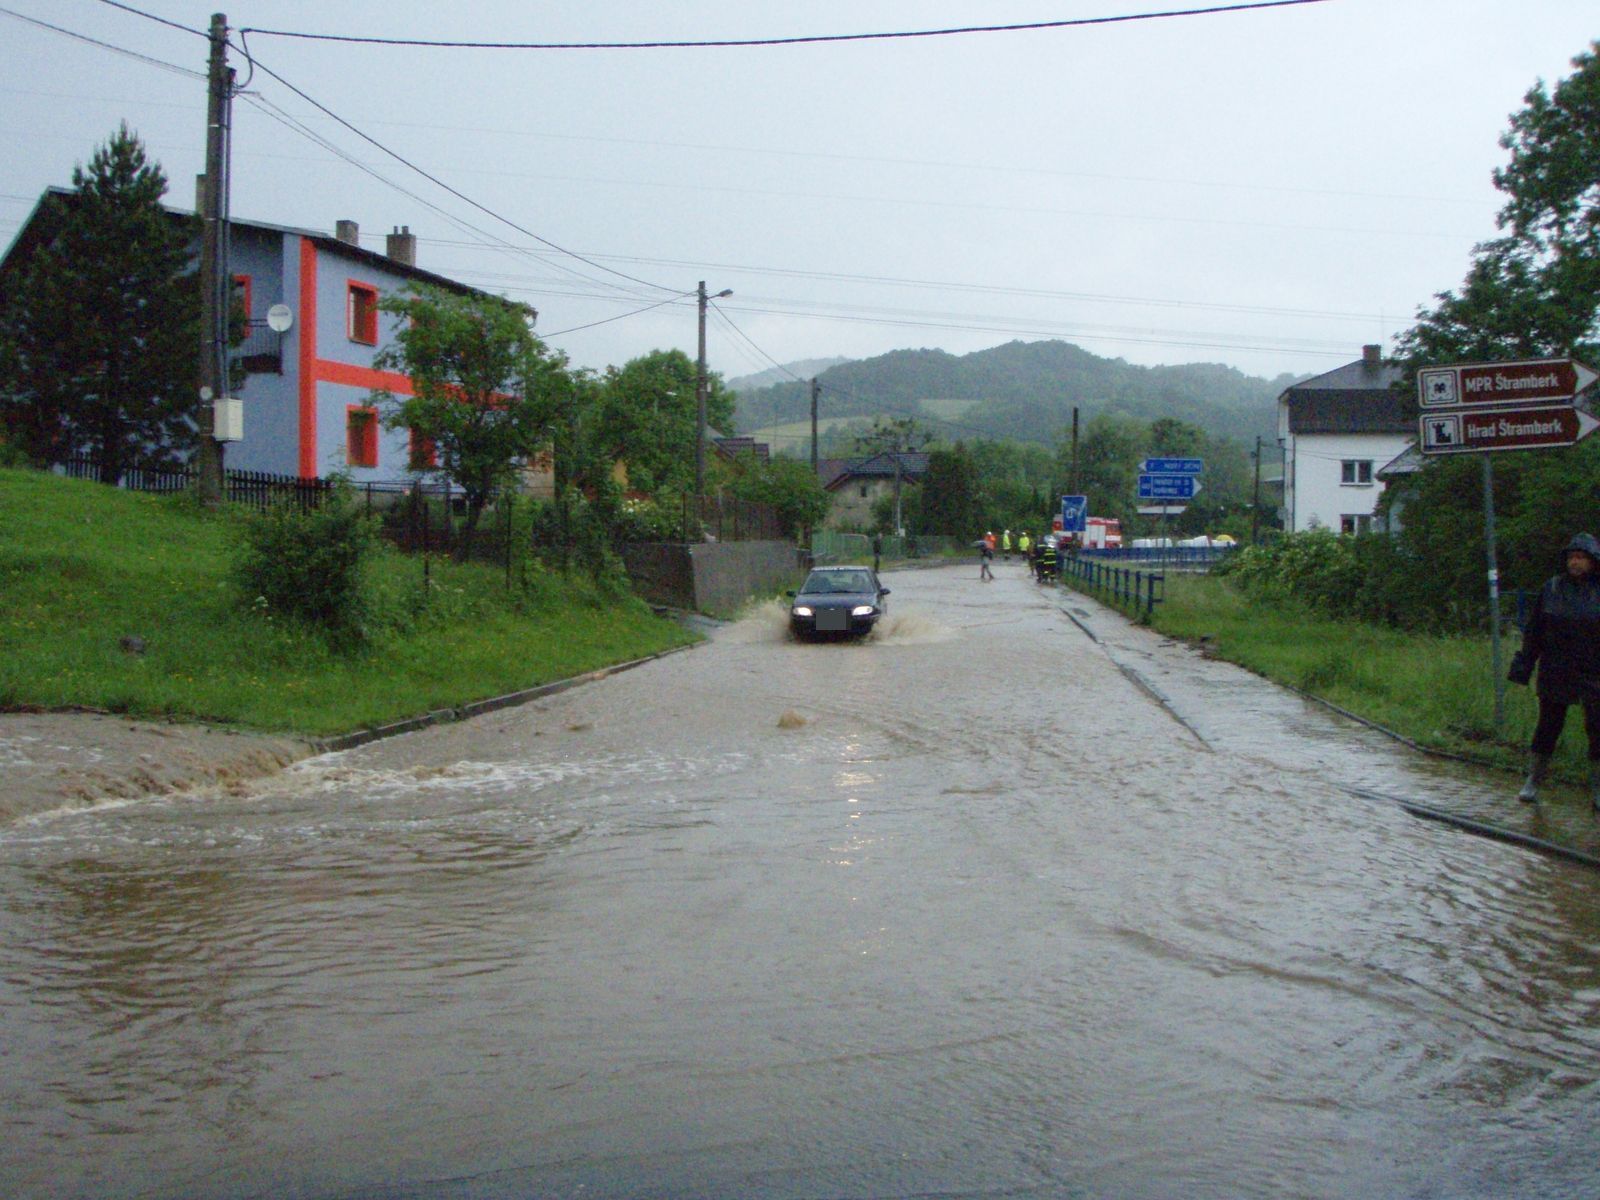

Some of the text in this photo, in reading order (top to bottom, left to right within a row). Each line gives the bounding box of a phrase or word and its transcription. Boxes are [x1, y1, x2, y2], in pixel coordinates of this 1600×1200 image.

[1466, 373, 1559, 392] MPR Štramberk
[1468, 419, 1562, 438] Hrad Štramberk
